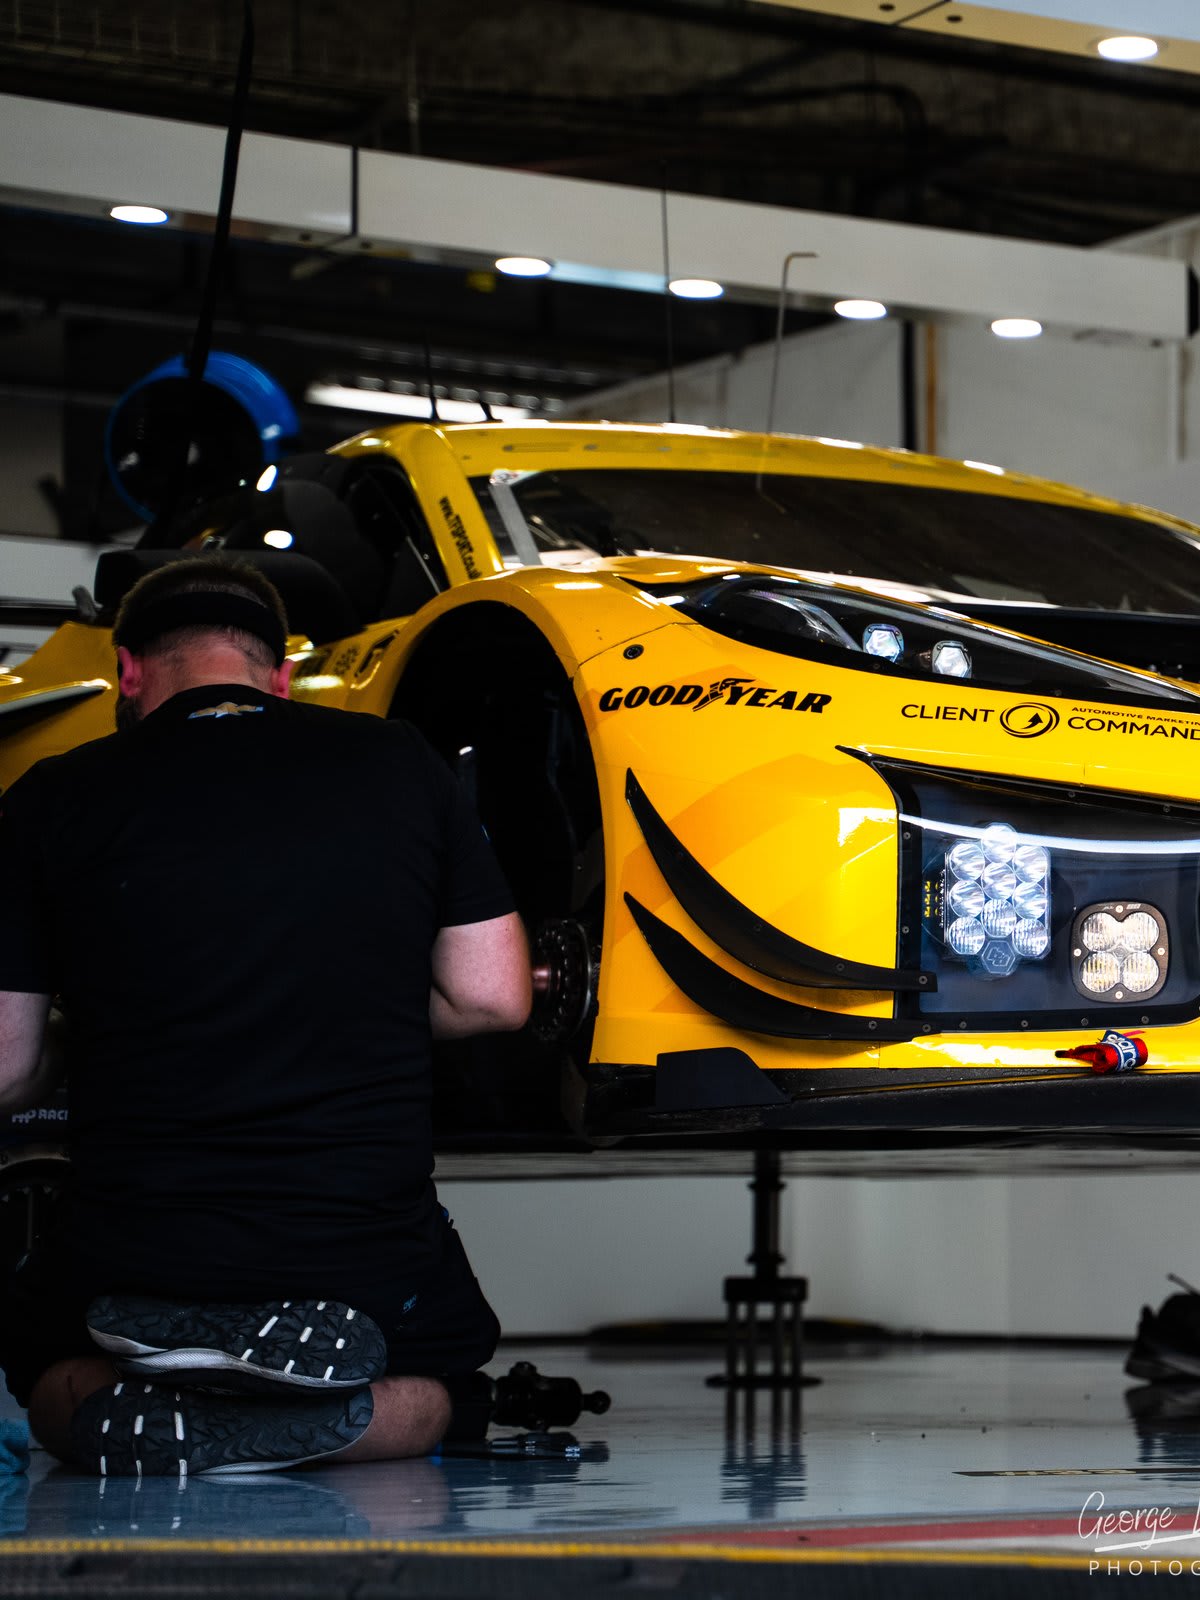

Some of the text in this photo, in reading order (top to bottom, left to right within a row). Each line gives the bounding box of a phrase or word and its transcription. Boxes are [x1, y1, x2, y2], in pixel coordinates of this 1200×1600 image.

[598, 677, 833, 714] GOODYEAR
[900, 704, 995, 723] CLIENT
[1071, 706, 1144, 720] AUTOMOTIVE
